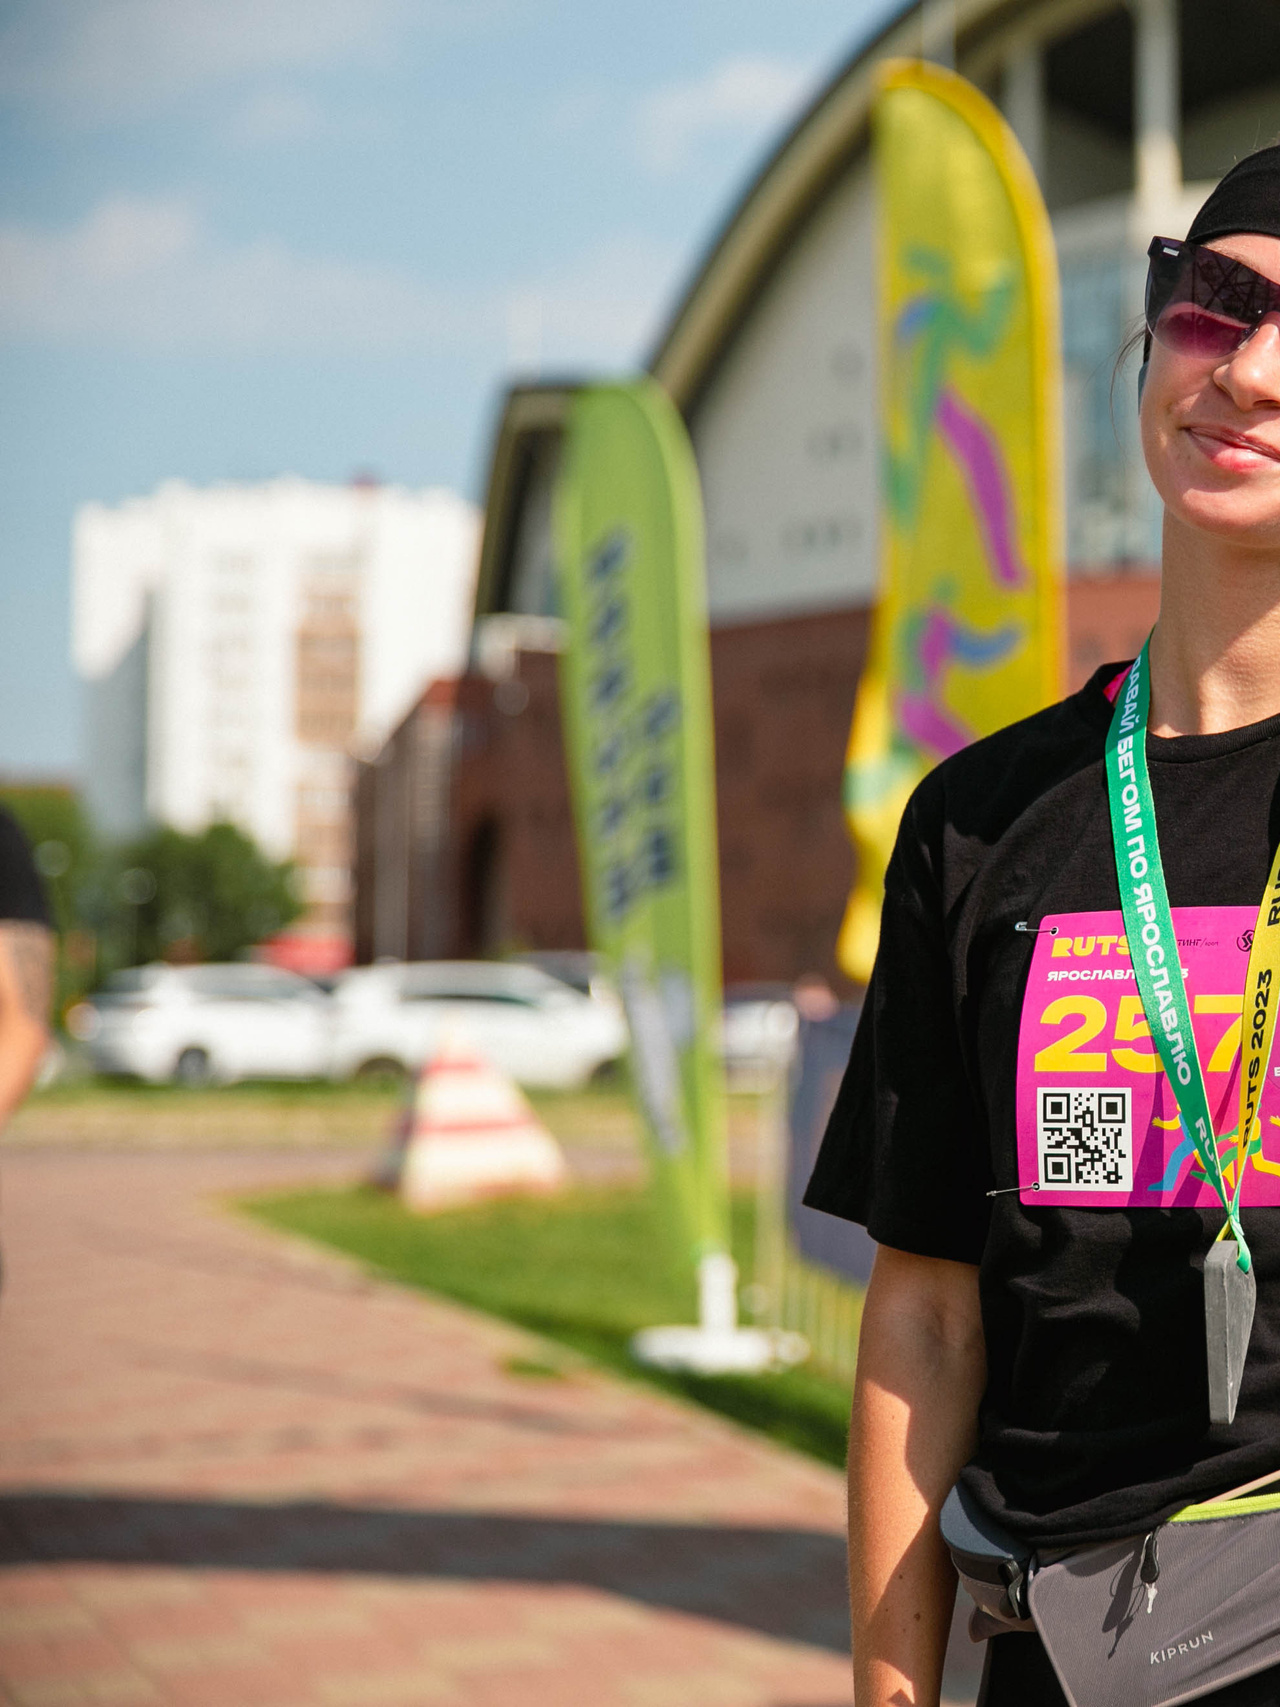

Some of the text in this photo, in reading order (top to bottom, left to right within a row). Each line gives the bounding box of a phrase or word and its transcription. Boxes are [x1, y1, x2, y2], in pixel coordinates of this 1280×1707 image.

[1117, 738, 1143, 831] БЕГОМ
[1127, 837, 1149, 879] ПО
[1047, 968, 1136, 982] ЯРОСЛАВЛ
[1133, 886, 1192, 1086] ЯРОСЛАВЛЮ
[1251, 968, 1273, 1051] 2023
[1034, 994, 1243, 1074] 257
[1150, 1630, 1214, 1665] KIPRUN
